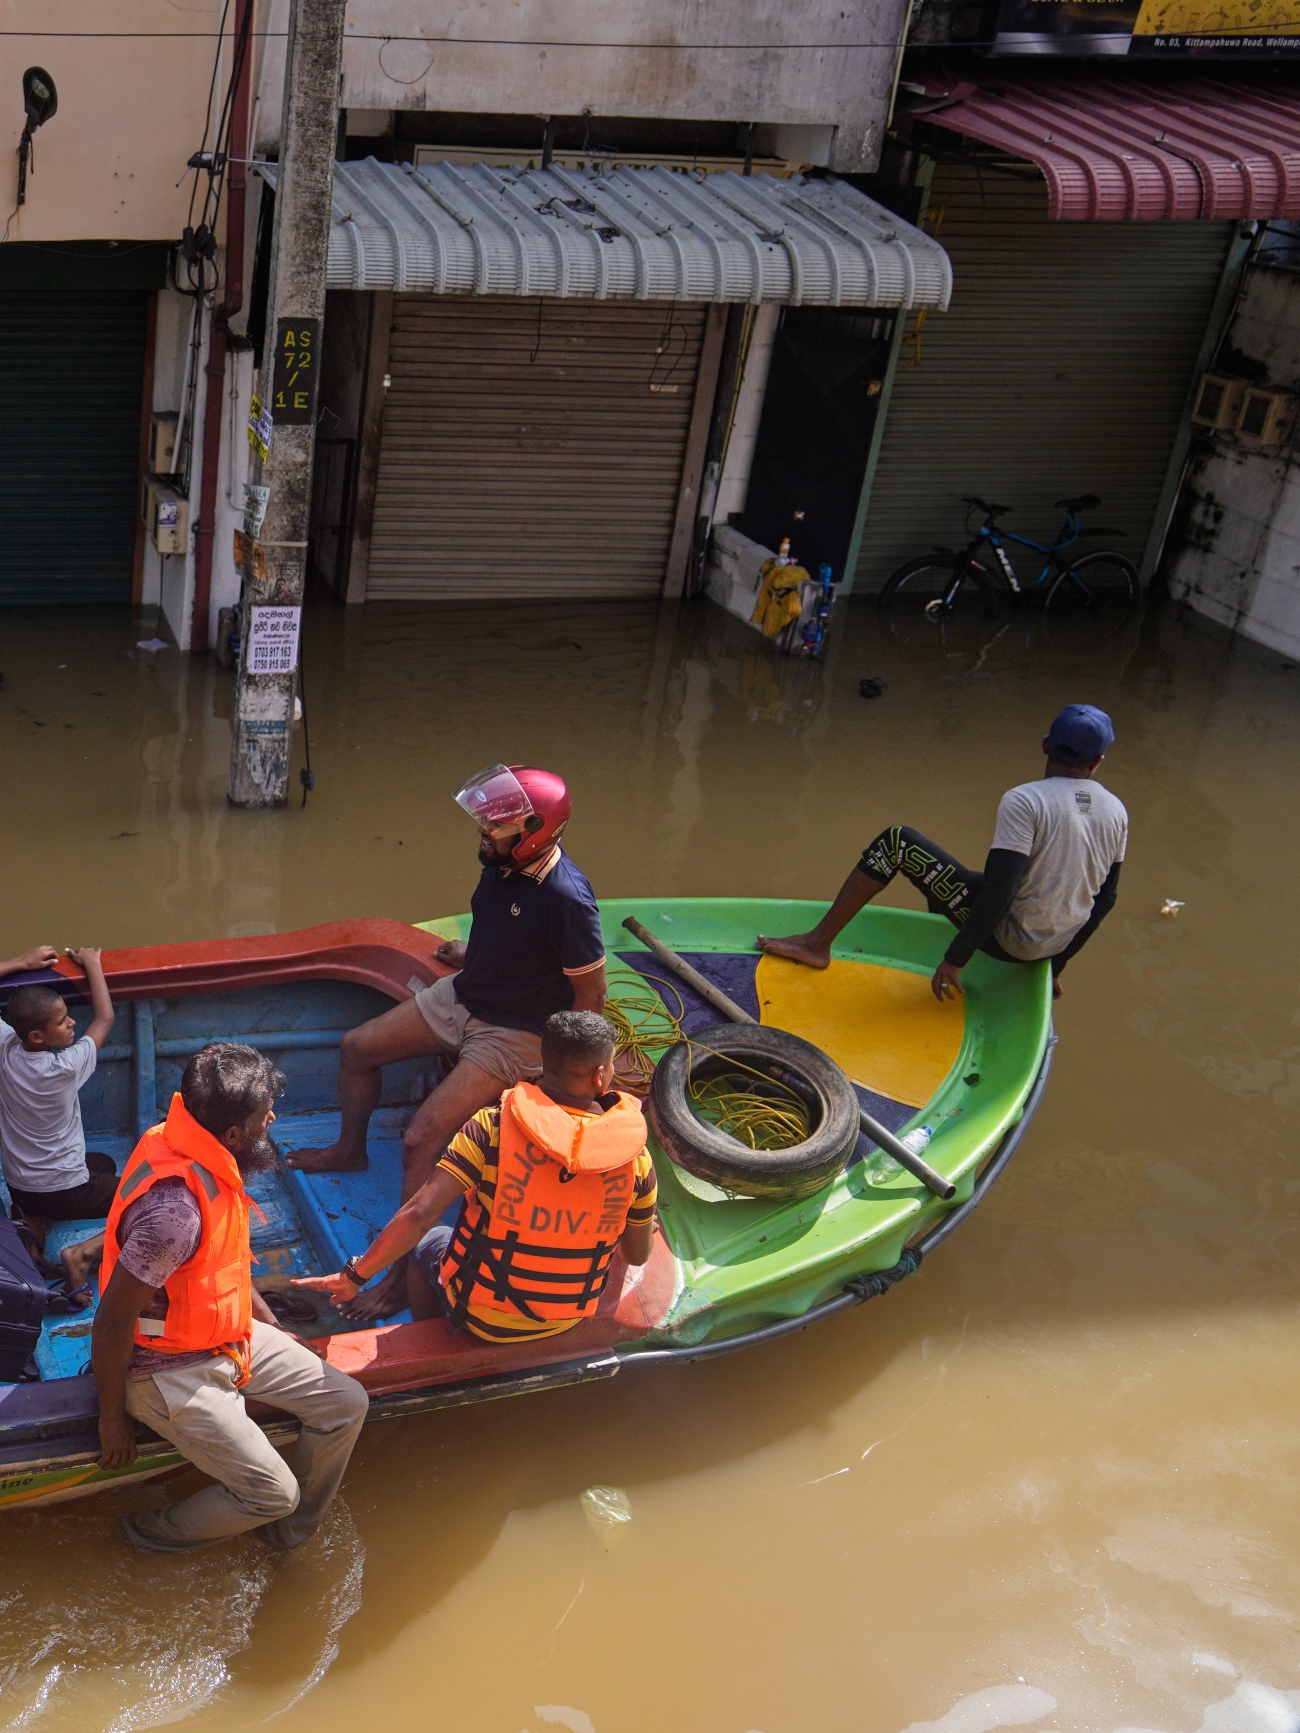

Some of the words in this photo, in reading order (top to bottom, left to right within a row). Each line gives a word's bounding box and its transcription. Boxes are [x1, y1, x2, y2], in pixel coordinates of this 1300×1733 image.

[283, 330, 312, 348] AS
[283, 353, 312, 369] 72
[254, 647, 269, 658] 0703
[269, 646, 280, 657] 917
[280, 646, 292, 657] 163
[253, 660, 268, 670] 0750
[268, 659, 279, 669] 915
[496, 1141, 554, 1226] POLIC
[596, 1171, 628, 1234] RINE
